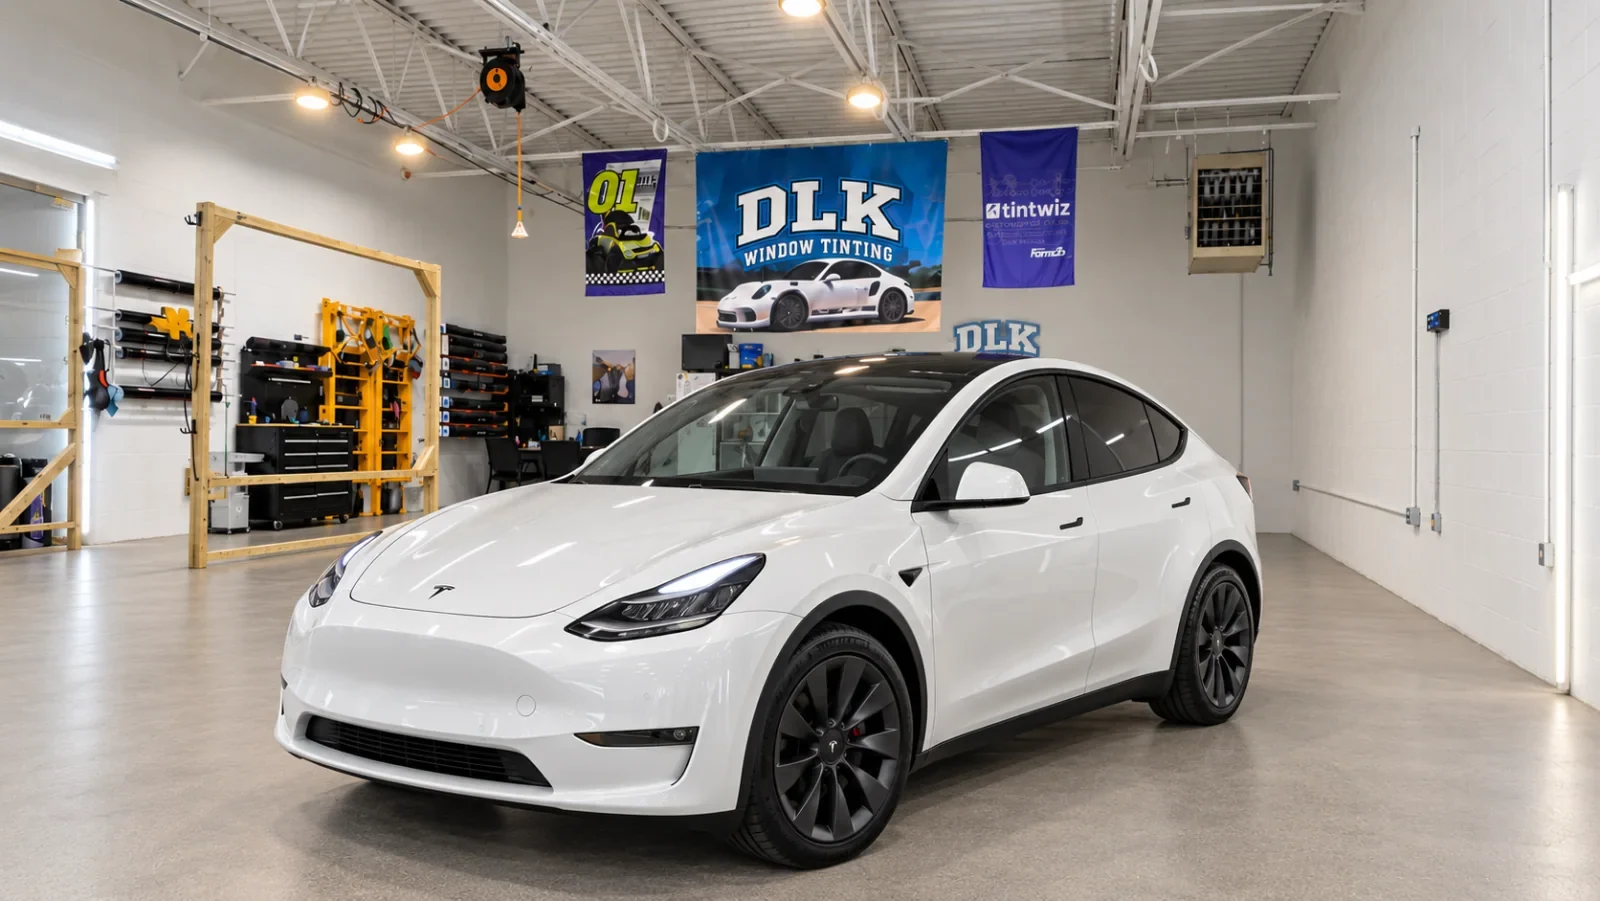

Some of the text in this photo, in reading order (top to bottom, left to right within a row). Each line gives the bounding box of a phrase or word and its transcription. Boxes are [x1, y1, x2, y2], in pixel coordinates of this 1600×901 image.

[587, 168, 639, 215] 01
[1002, 198, 1070, 218] tintwiz
[736, 178, 902, 249] DLK
[744, 238, 893, 266] WINDOW TINTING
[955, 321, 1038, 355] DLK
